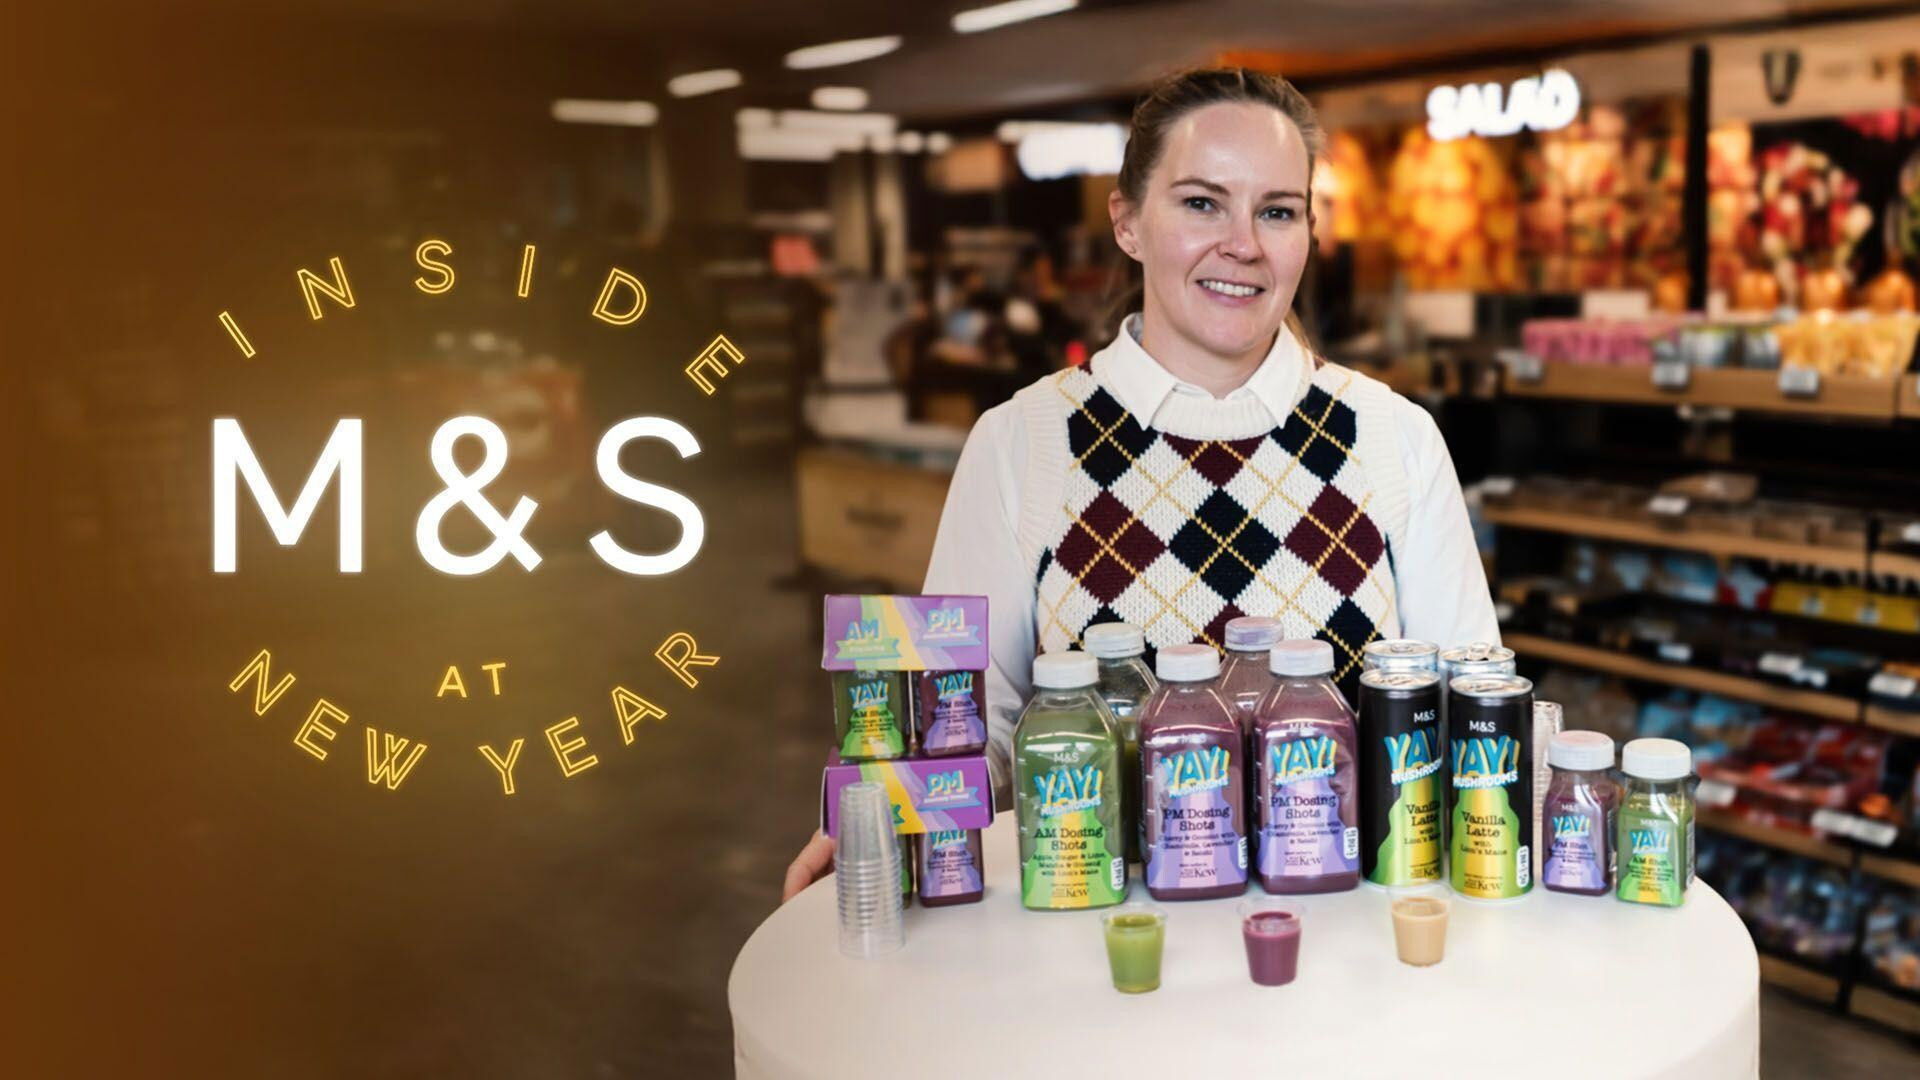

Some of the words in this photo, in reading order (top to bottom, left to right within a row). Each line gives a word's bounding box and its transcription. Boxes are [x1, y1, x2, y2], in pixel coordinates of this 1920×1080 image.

[927, 607, 966, 632] PM
[846, 618, 882, 643] AM
[1414, 708, 1435, 722] M&S
[1469, 720, 1496, 733] M&S
[1053, 751, 1079, 763] M&S
[1269, 733, 1337, 776] YAY!
[1451, 735, 1520, 776] YAY!
[1161, 744, 1230, 789] YAY!
[927, 770, 963, 797] PM
[1033, 762, 1103, 808] YAY!
[1453, 770, 1518, 788] MUSHROOMS
[1271, 796, 1291, 808] PM
[1294, 795, 1336, 808] Dosing
[1164, 808, 1185, 819] PM
[1188, 807, 1231, 820] Dosing
[1285, 808, 1321, 819] Shots
[1461, 811, 1506, 825] Vanilla
[1035, 828, 1057, 838] AM
[1059, 826, 1104, 839] Dosing
[1179, 820, 1215, 831] Shots
[1466, 824, 1500, 837] Latte
[1051, 840, 1088, 850] Shots
